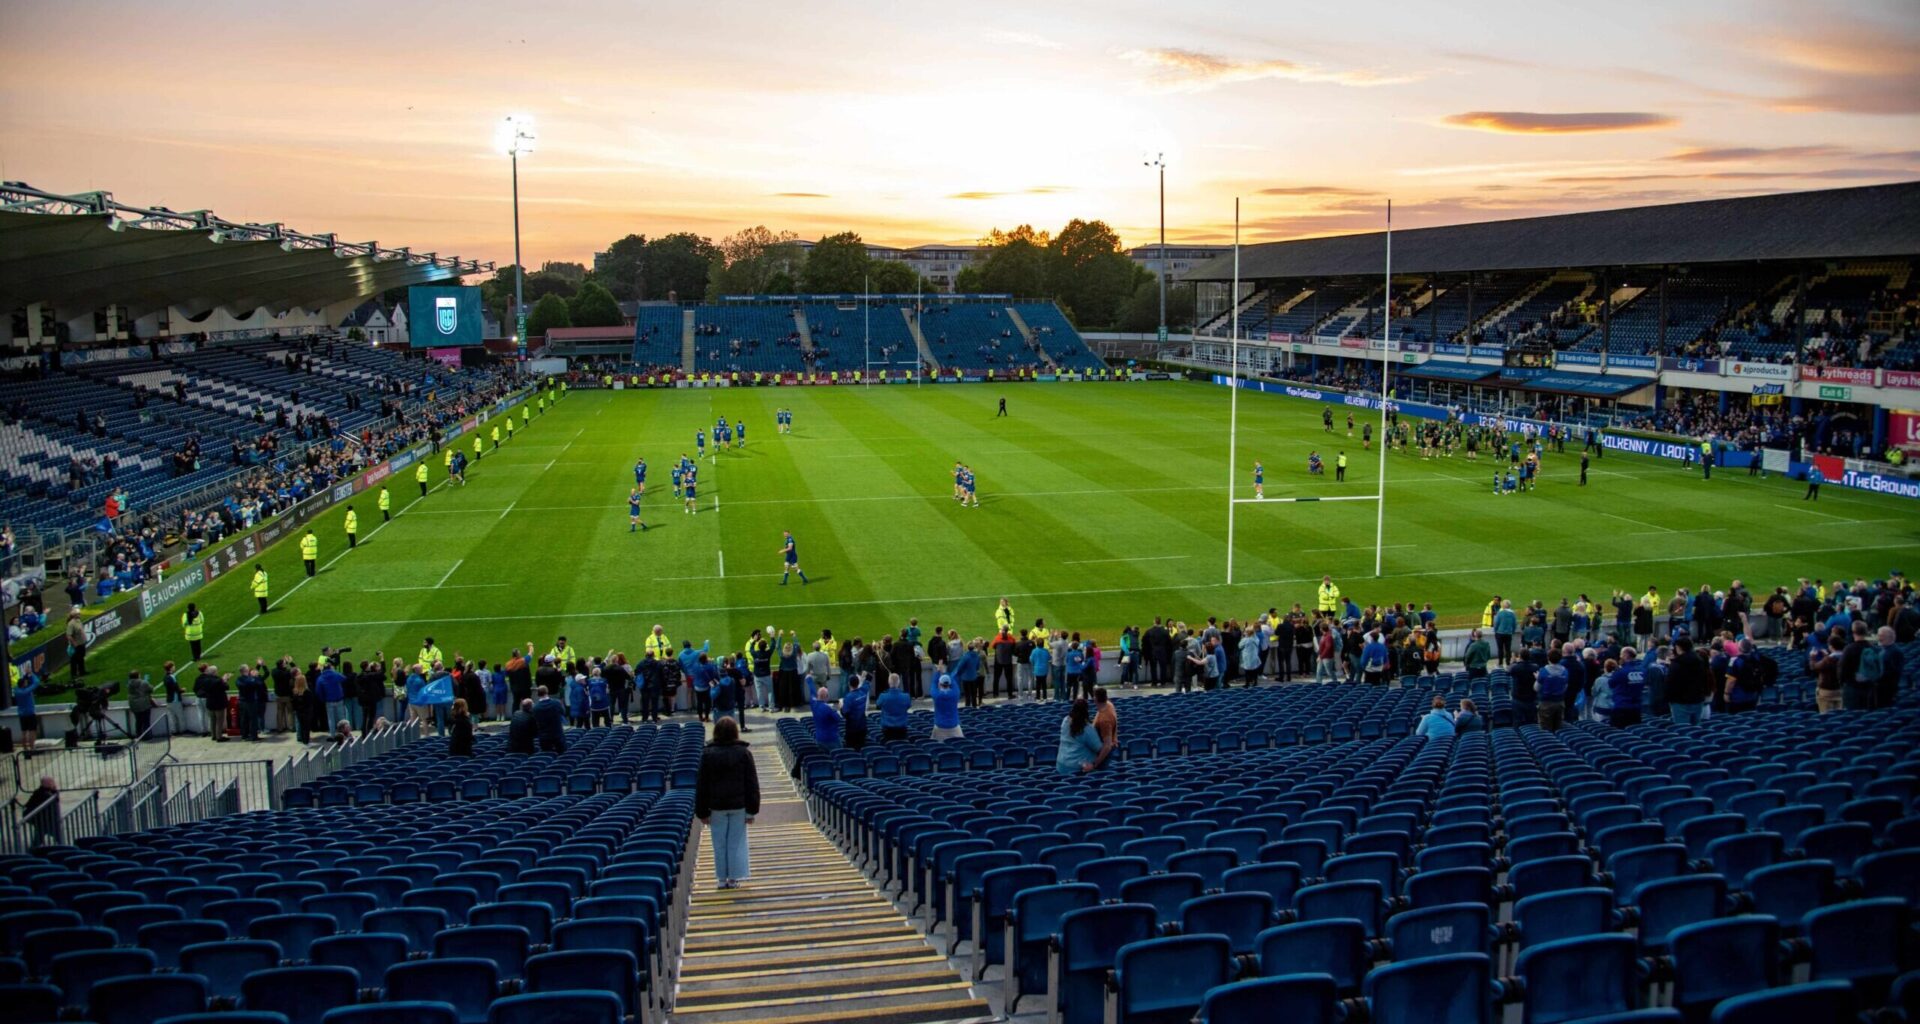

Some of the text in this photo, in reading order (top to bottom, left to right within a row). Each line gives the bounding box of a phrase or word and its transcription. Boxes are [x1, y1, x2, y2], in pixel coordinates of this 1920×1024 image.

[1743, 366, 1788, 376] ajproducts.ie
[1887, 373, 1908, 386] laya
[1822, 388, 1836, 397] Exit
[1602, 435, 1649, 453] KILKENNY
